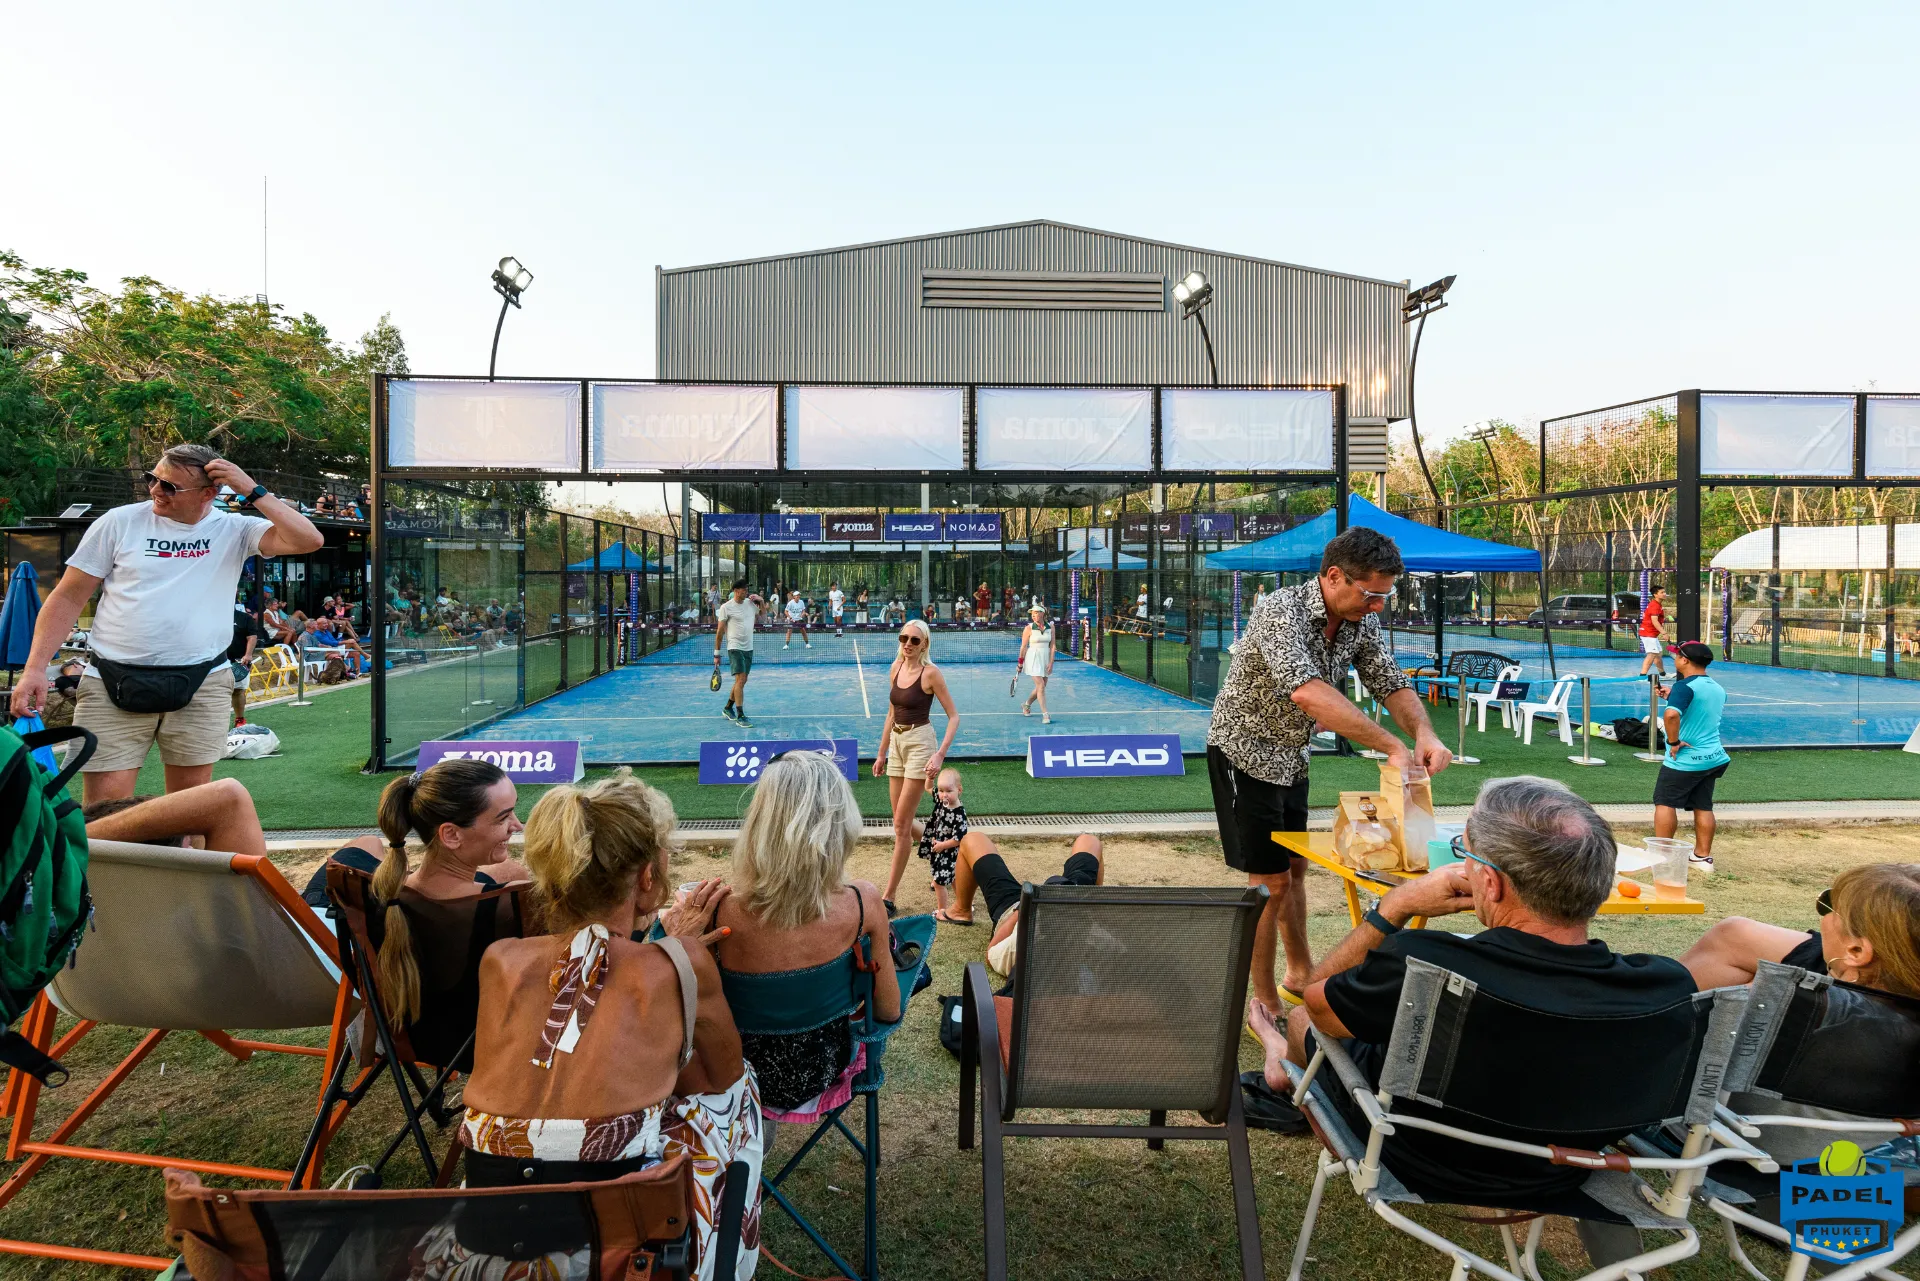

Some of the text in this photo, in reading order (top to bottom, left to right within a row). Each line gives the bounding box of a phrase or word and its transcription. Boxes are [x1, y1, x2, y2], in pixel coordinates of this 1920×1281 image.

[891, 524, 935, 532] HEAD
[949, 522, 996, 532] NOMAD
[146, 538, 211, 552] TOMMY
[1697, 1063, 1723, 1098] MONTI
